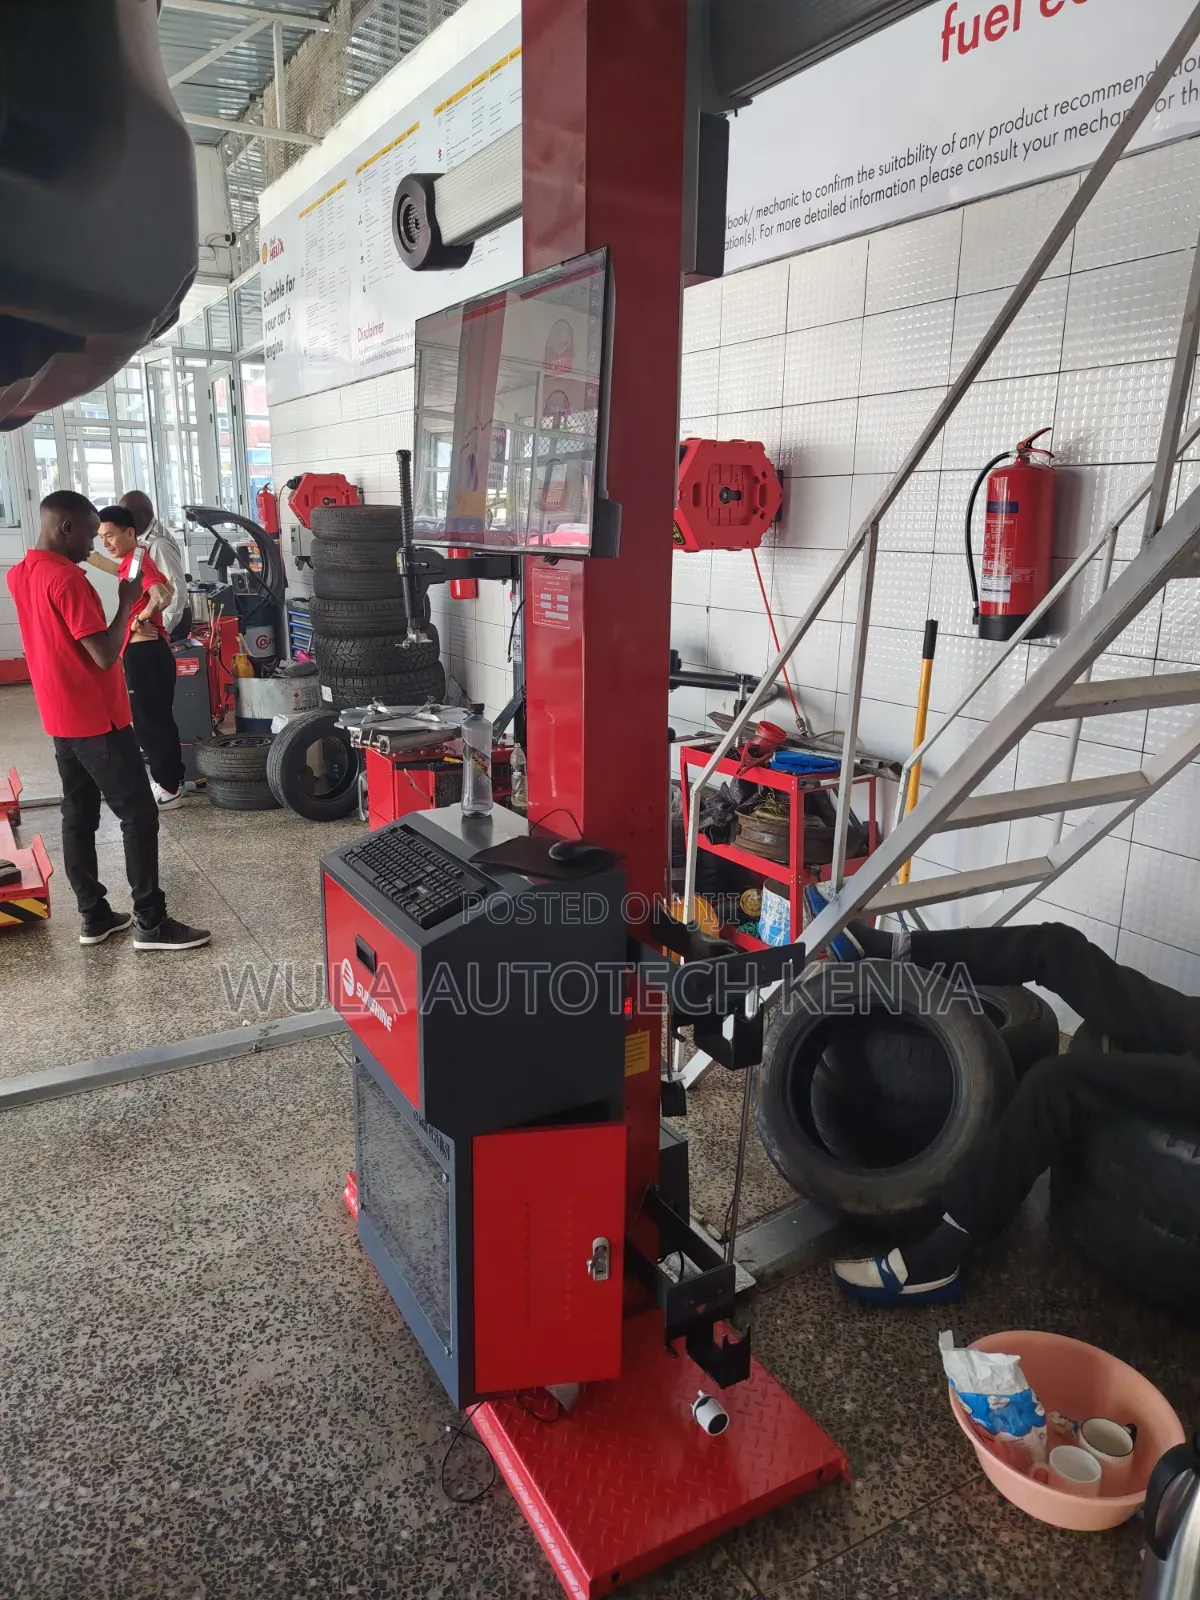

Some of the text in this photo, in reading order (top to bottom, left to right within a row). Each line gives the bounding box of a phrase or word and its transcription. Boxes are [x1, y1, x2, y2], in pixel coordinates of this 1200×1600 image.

[941, 0, 1021, 62] fuel
[725, 206, 754, 230] book/
[756, 193, 799, 220] mechanic
[802, 190, 812, 204] to
[815, 174, 854, 199] confirm
[857, 165, 875, 184] the
[878, 143, 938, 176] suitability
[941, 132, 956, 156] of
[959, 129, 985, 150] any
[988, 104, 1048, 145] product
[760, 223, 774, 239] For
[776, 215, 801, 235] more
[804, 195, 846, 225] detailed
[849, 179, 916, 210] information
[920, 165, 963, 193] please
[967, 138, 1018, 172] consult
[1022, 131, 1059, 161] your
[1155, 94, 1175, 113] or
[263, 274, 295, 308] Suitable for
[265, 304, 291, 338] your car's
[358, 321, 385, 342] Disclaimer
[266, 336, 284, 361] engine
[356, 982, 393, 1032] SUNSHINE
